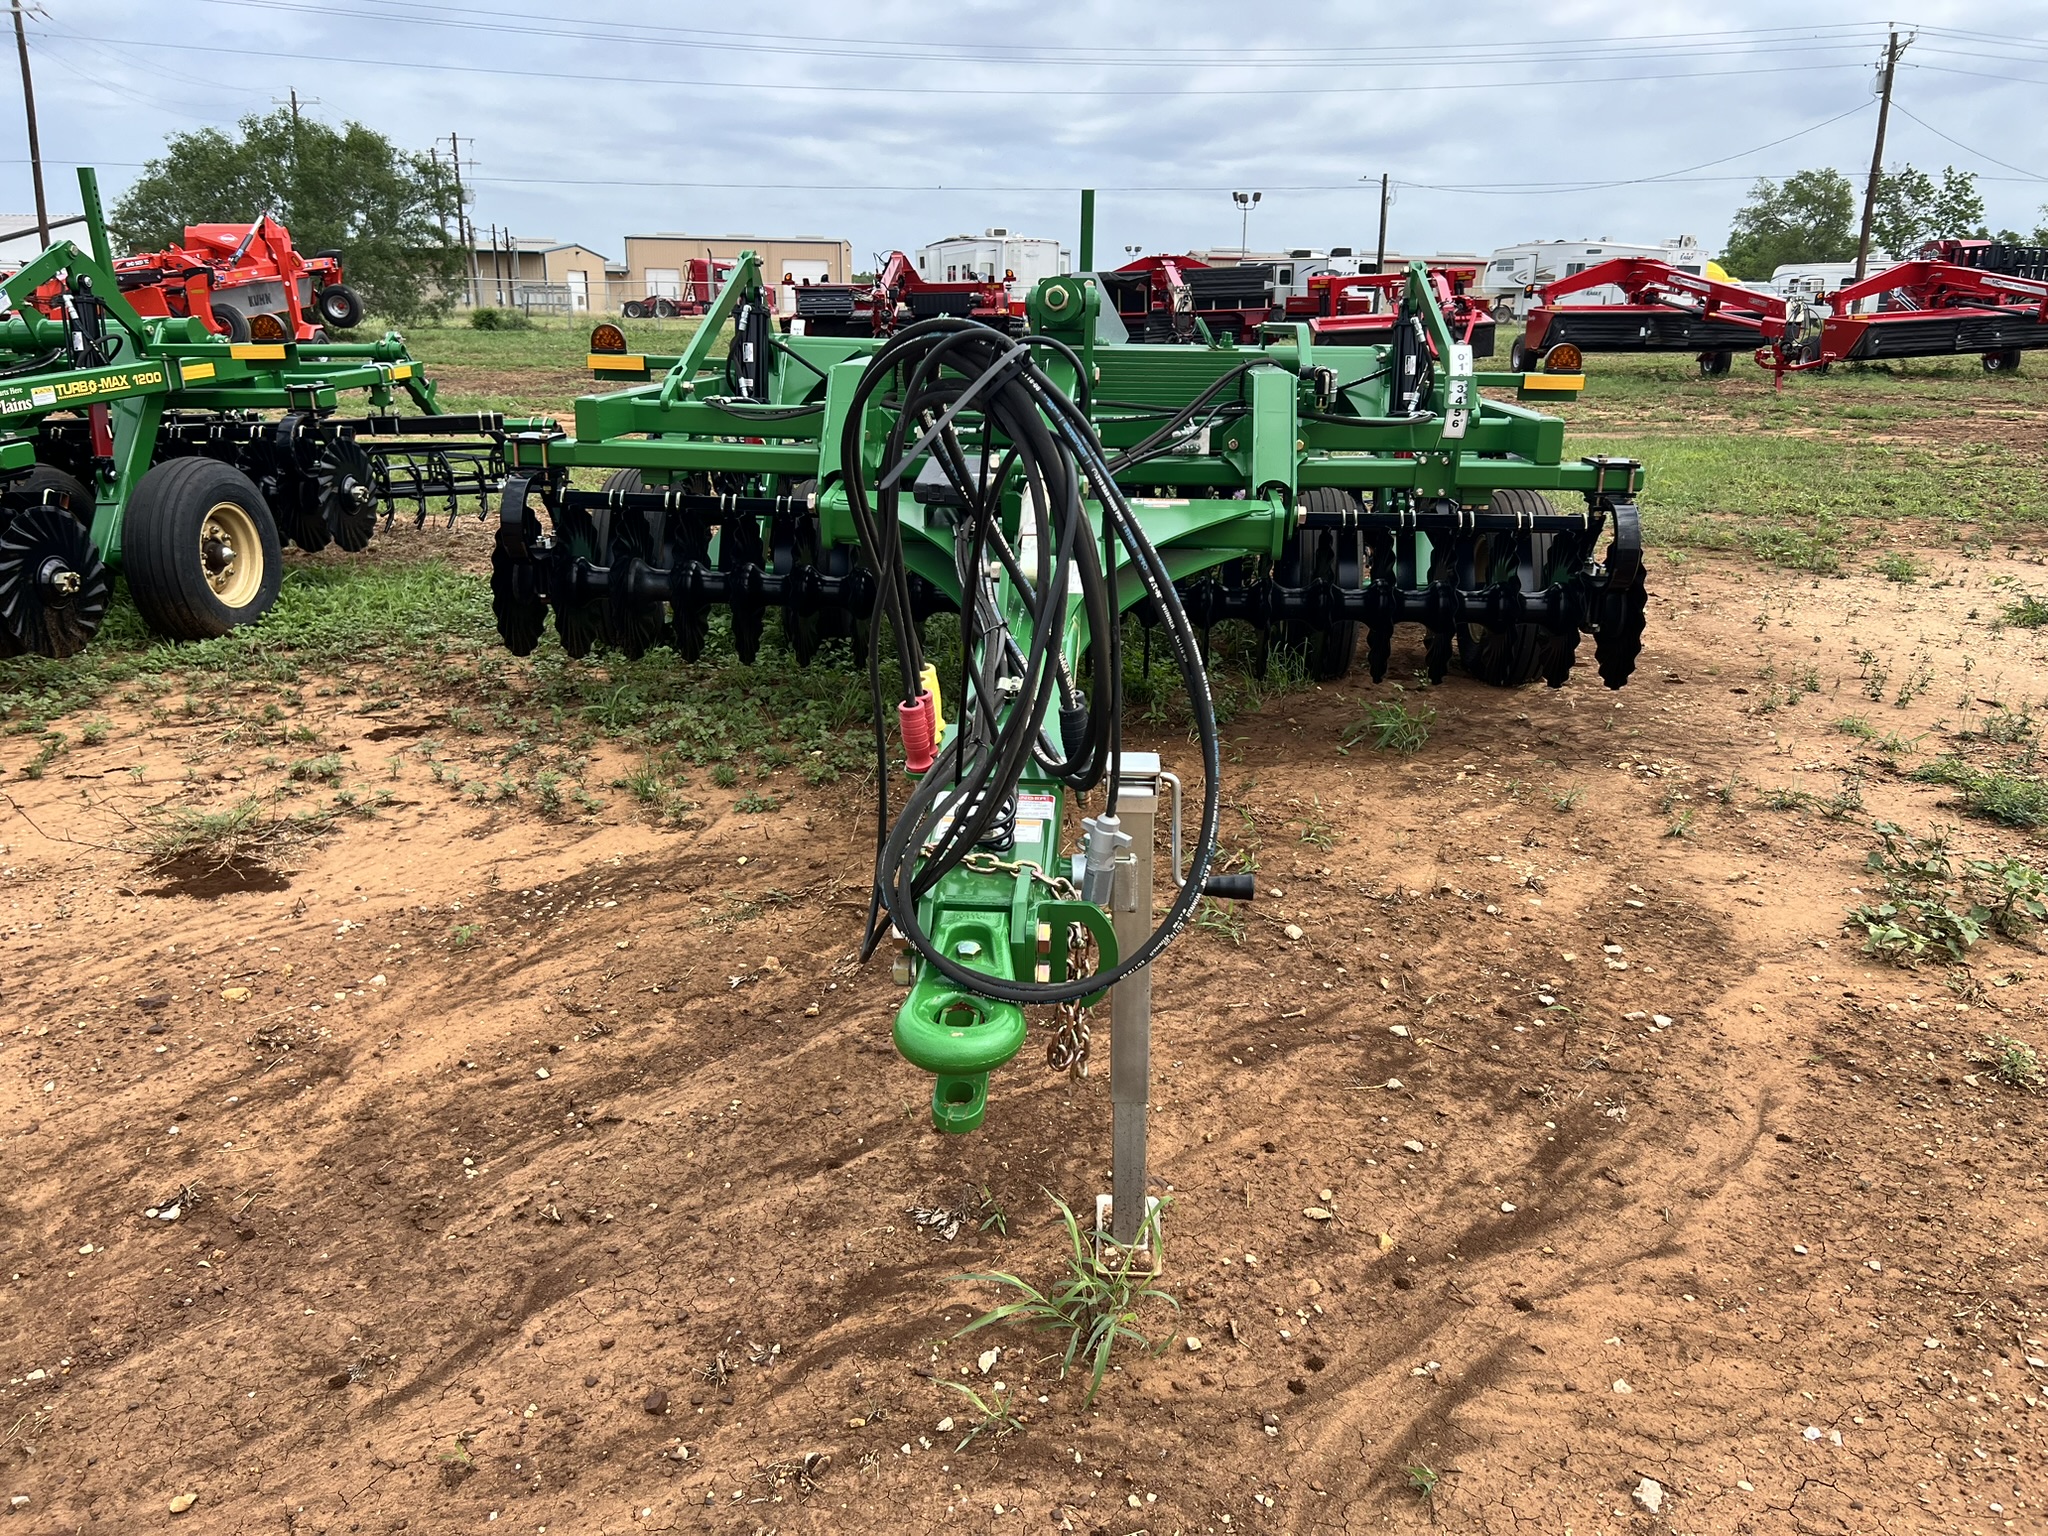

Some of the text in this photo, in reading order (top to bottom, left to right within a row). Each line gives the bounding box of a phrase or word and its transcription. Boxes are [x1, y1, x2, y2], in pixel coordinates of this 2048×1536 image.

[248, 292, 272, 307] KUHN
[9, 387, 23, 395] Here
[55, 372, 162, 395] TURBO-MAX 1200
[0, 398, 33, 414] lains
[1161, 602, 1175, 630] WINNER
[1186, 892, 1202, 918] WINNER
